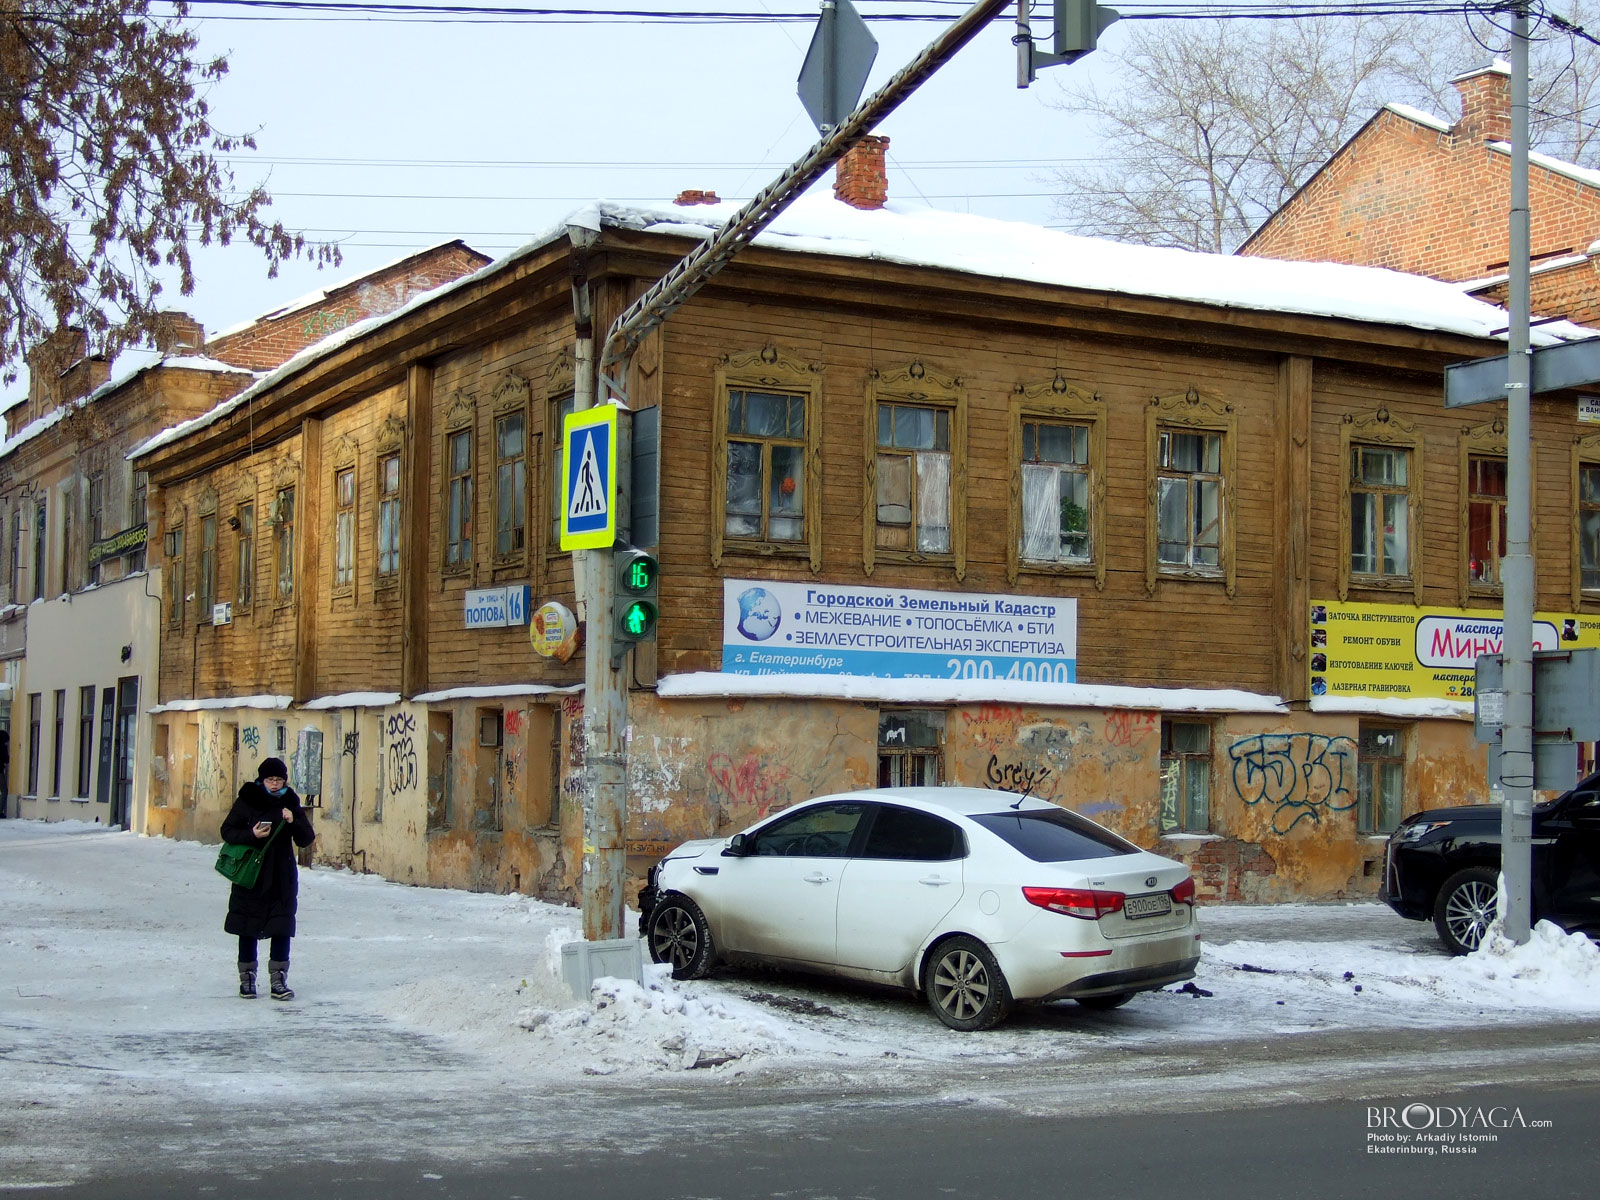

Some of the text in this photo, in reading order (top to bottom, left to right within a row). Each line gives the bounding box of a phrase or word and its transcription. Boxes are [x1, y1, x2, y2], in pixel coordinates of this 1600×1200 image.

[632, 562, 648, 587] 16
[509, 592, 521, 620] 16
[807, 590, 1056, 618] Городской Земельный Кадастр
[466, 607, 505, 623] ПОПОВА
[805, 611, 1055, 635] МЕЖЕВАНИЕ ТОПОСЪЁМКА БТИ
[1329, 612, 1415, 624] ЗАТОЧКА ИНСТРУМЕНТОВ
[795, 631, 1065, 655] ЗЕМЛЕУСТРОИТЕЛЬНАЯ ЭКСПЕРТИЗА
[1343, 636, 1401, 646] РЕМОНТ ОБУВИ
[735, 651, 844, 668] г. Екатеринбург
[1329, 660, 1414, 671] ИЗГОТОВЛЕНИЕ КЛЮЧЕЙ
[946, 658, 1068, 684] 200-4000
[1332, 683, 1411, 693] ЛАЗЕРНАЯ ГРАВИРОВКА
[1460, 686, 1475, 697] 28
